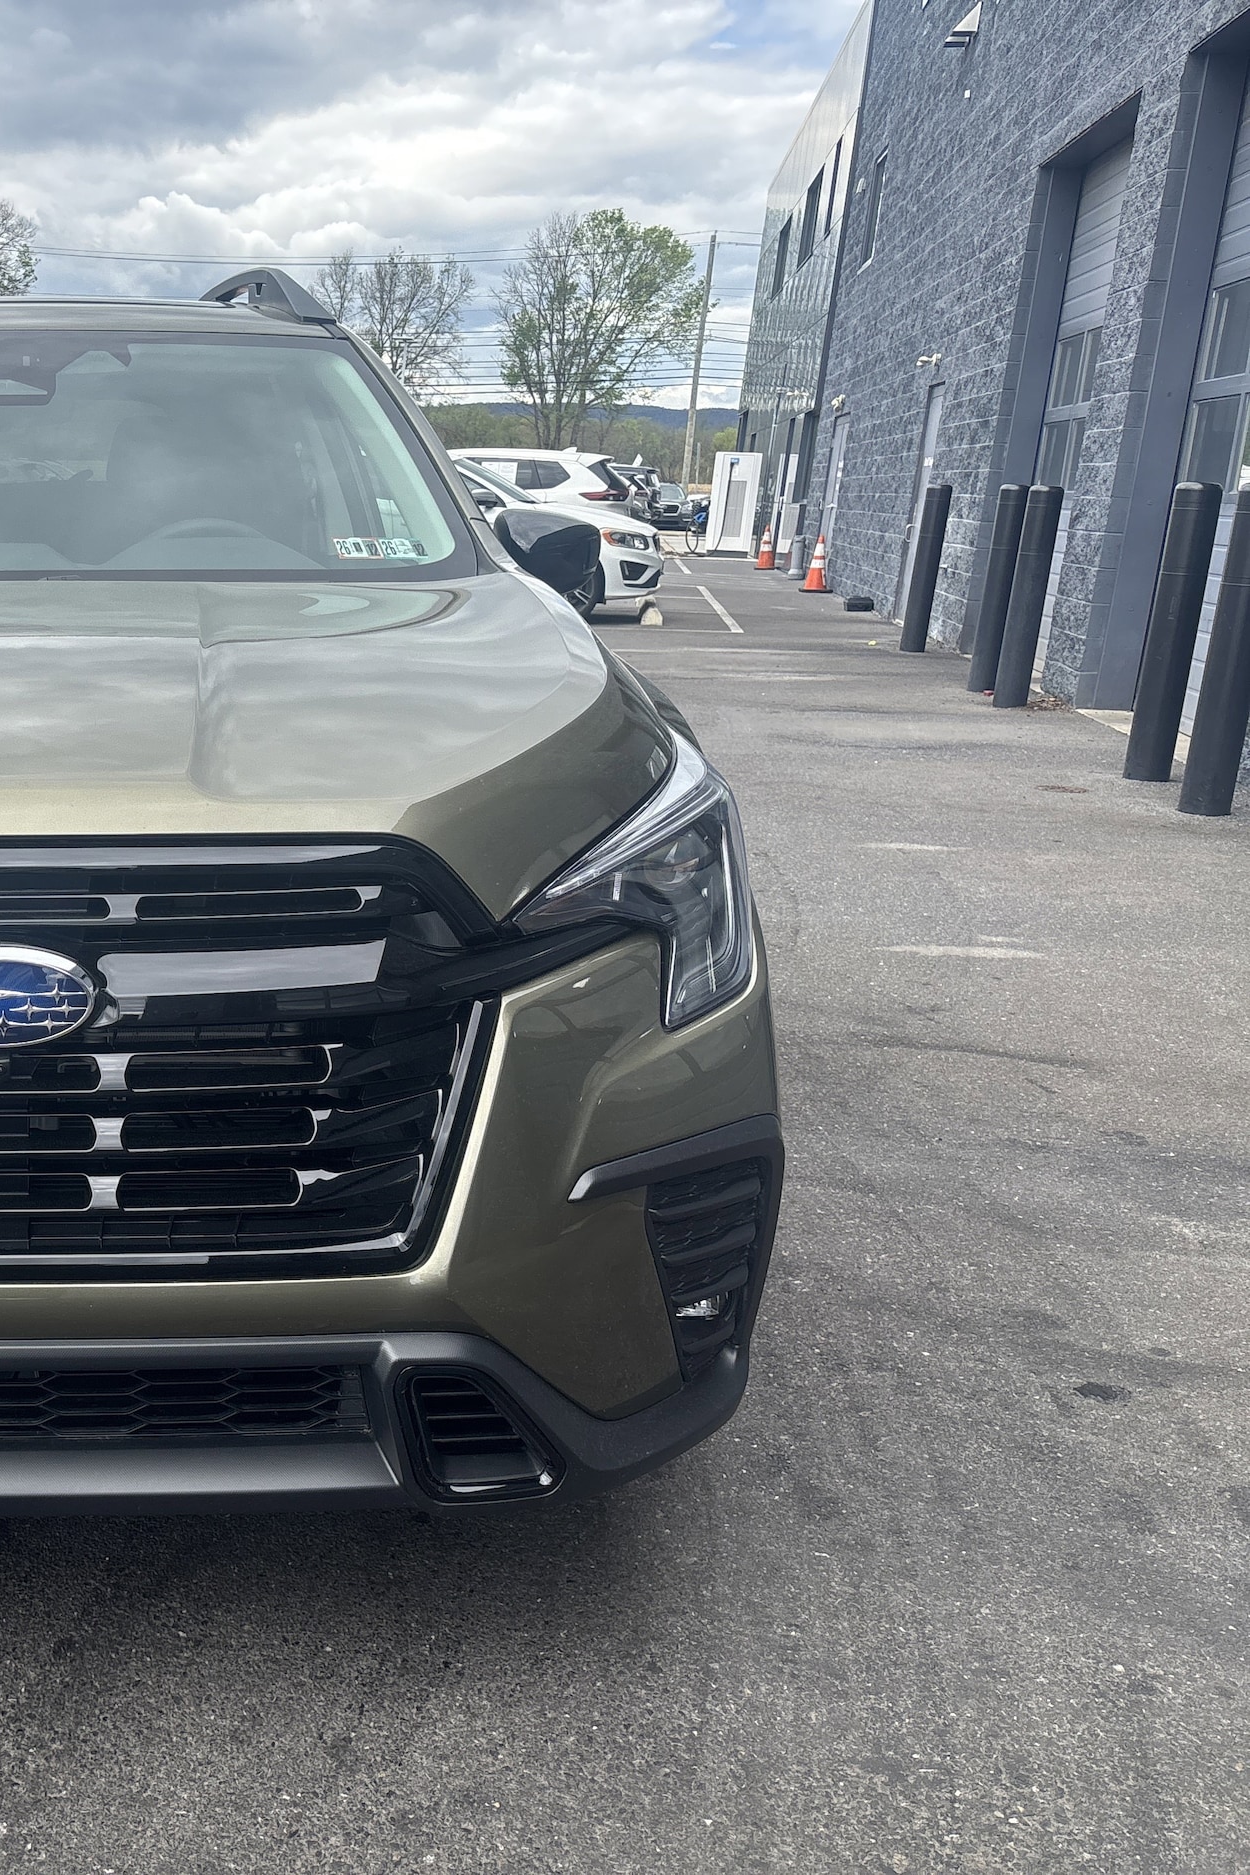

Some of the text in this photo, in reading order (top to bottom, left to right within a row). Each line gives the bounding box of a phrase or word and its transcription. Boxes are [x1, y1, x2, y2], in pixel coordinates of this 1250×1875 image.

[336, 540, 381, 556] 26 12
[382, 541, 428, 556] 26 12
